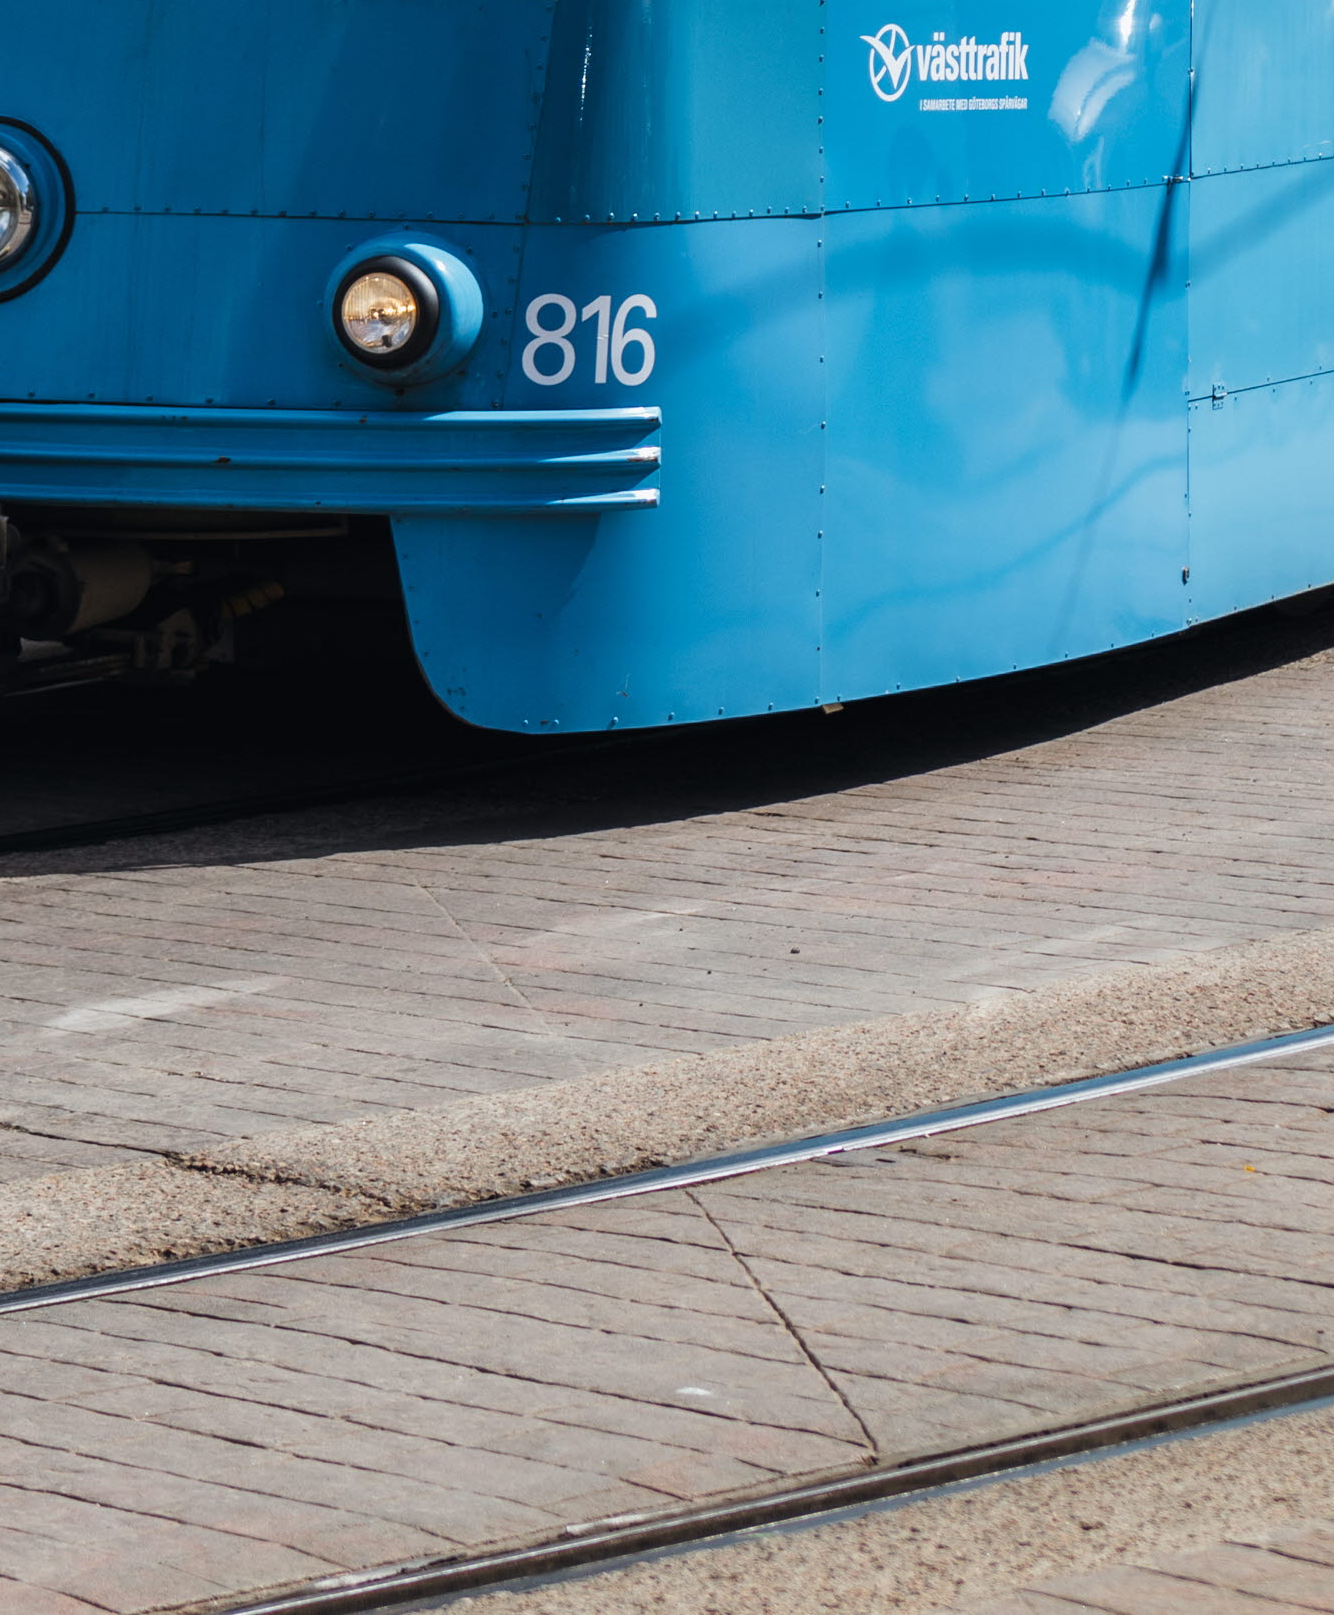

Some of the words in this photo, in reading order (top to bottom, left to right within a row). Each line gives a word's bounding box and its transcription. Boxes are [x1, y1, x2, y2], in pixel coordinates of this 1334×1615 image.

[916, 31, 1029, 81] västtrafik
[923, 98, 956, 111] SAMARBETE
[956, 98, 968, 111] MED
[968, 96, 998, 111] GÖTEBORGS
[999, 95, 1028, 110] SPÅRVÄGAR
[521, 292, 658, 387] 816
